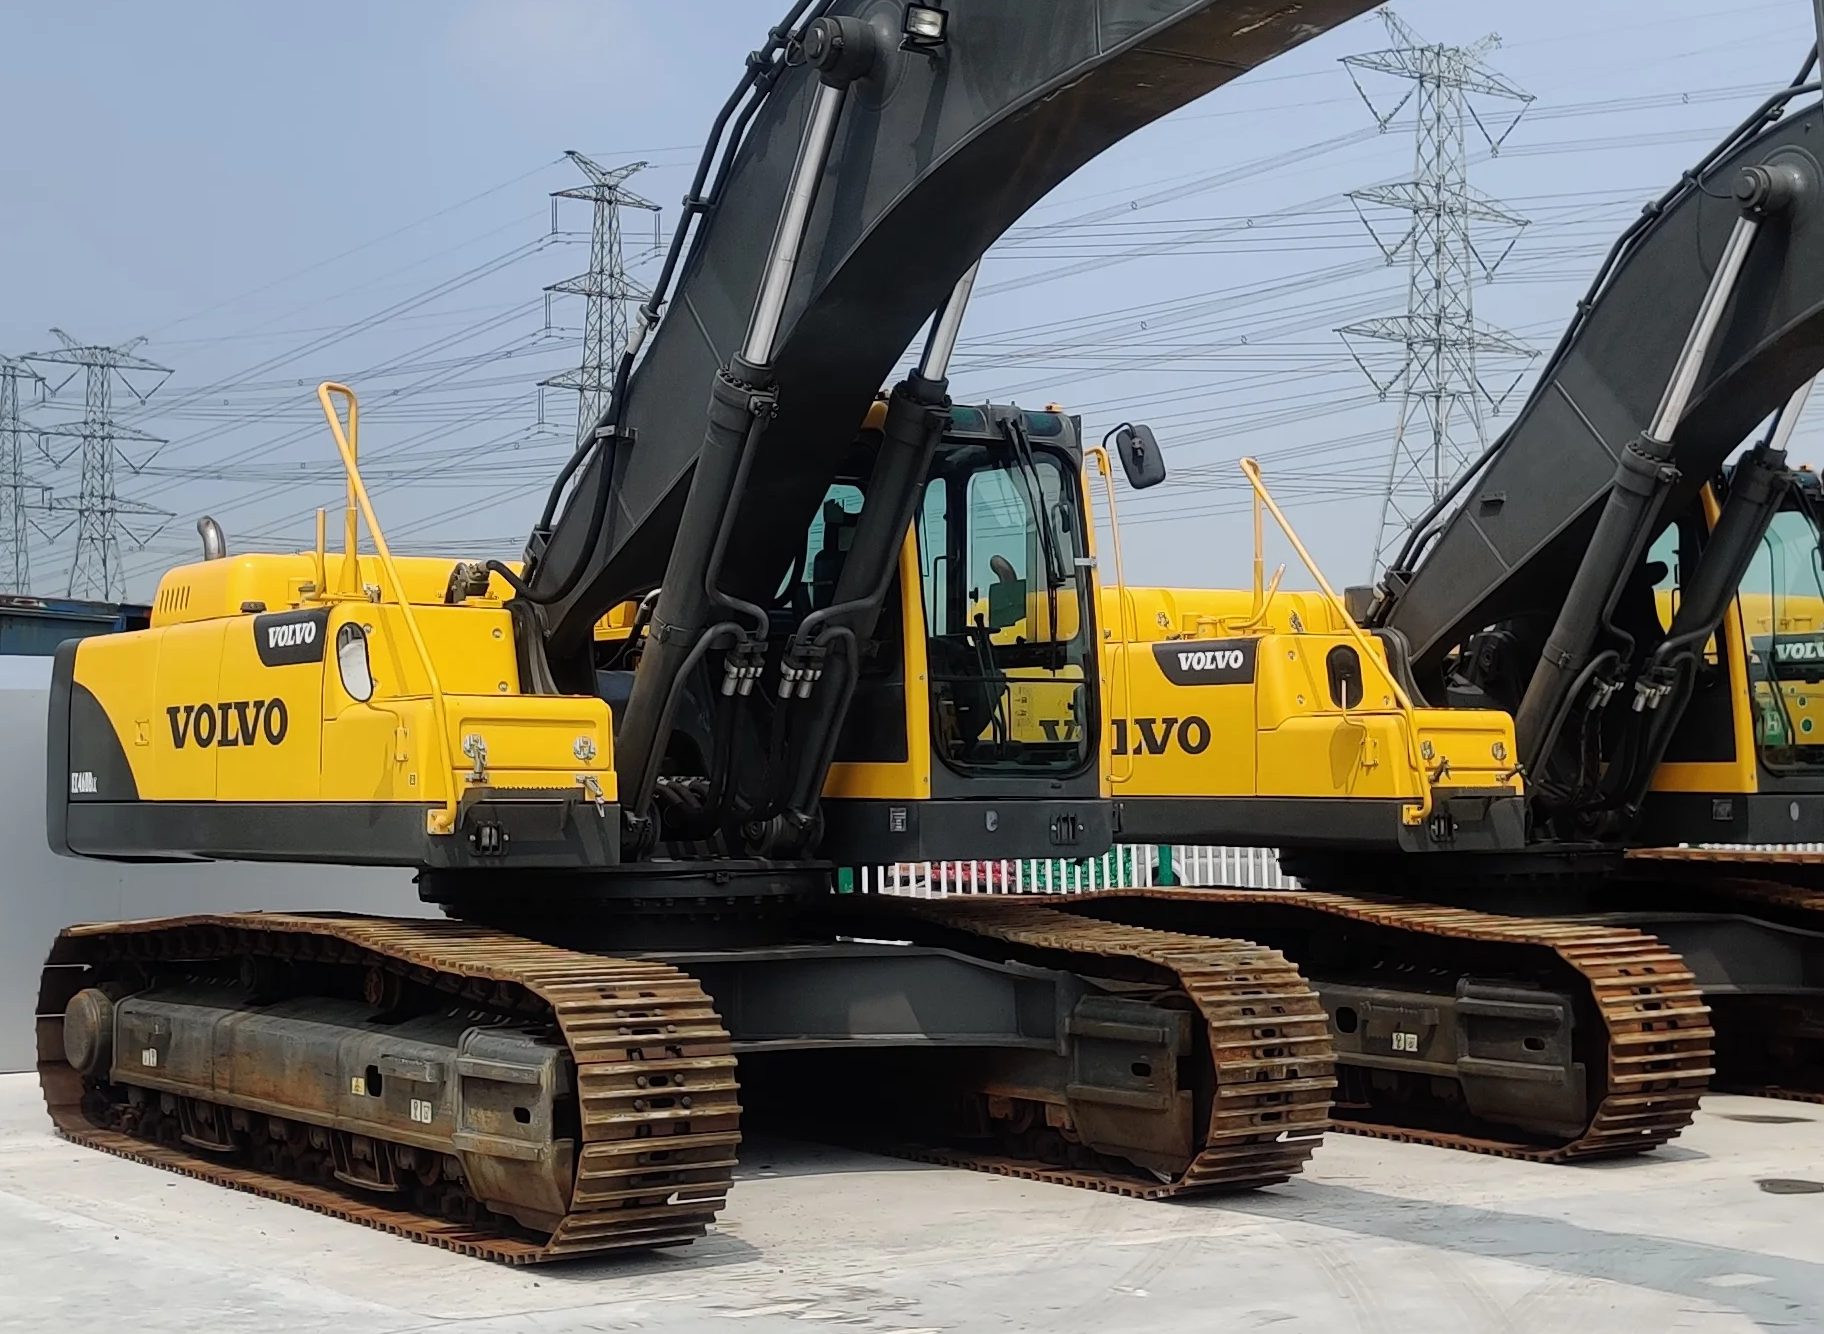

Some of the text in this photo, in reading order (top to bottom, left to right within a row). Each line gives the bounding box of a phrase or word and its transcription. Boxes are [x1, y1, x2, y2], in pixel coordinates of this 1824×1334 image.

[268, 621, 316, 649] VOLVO
[1177, 649, 1244, 671] VOLVO
[166, 697, 289, 749] VOLVO
